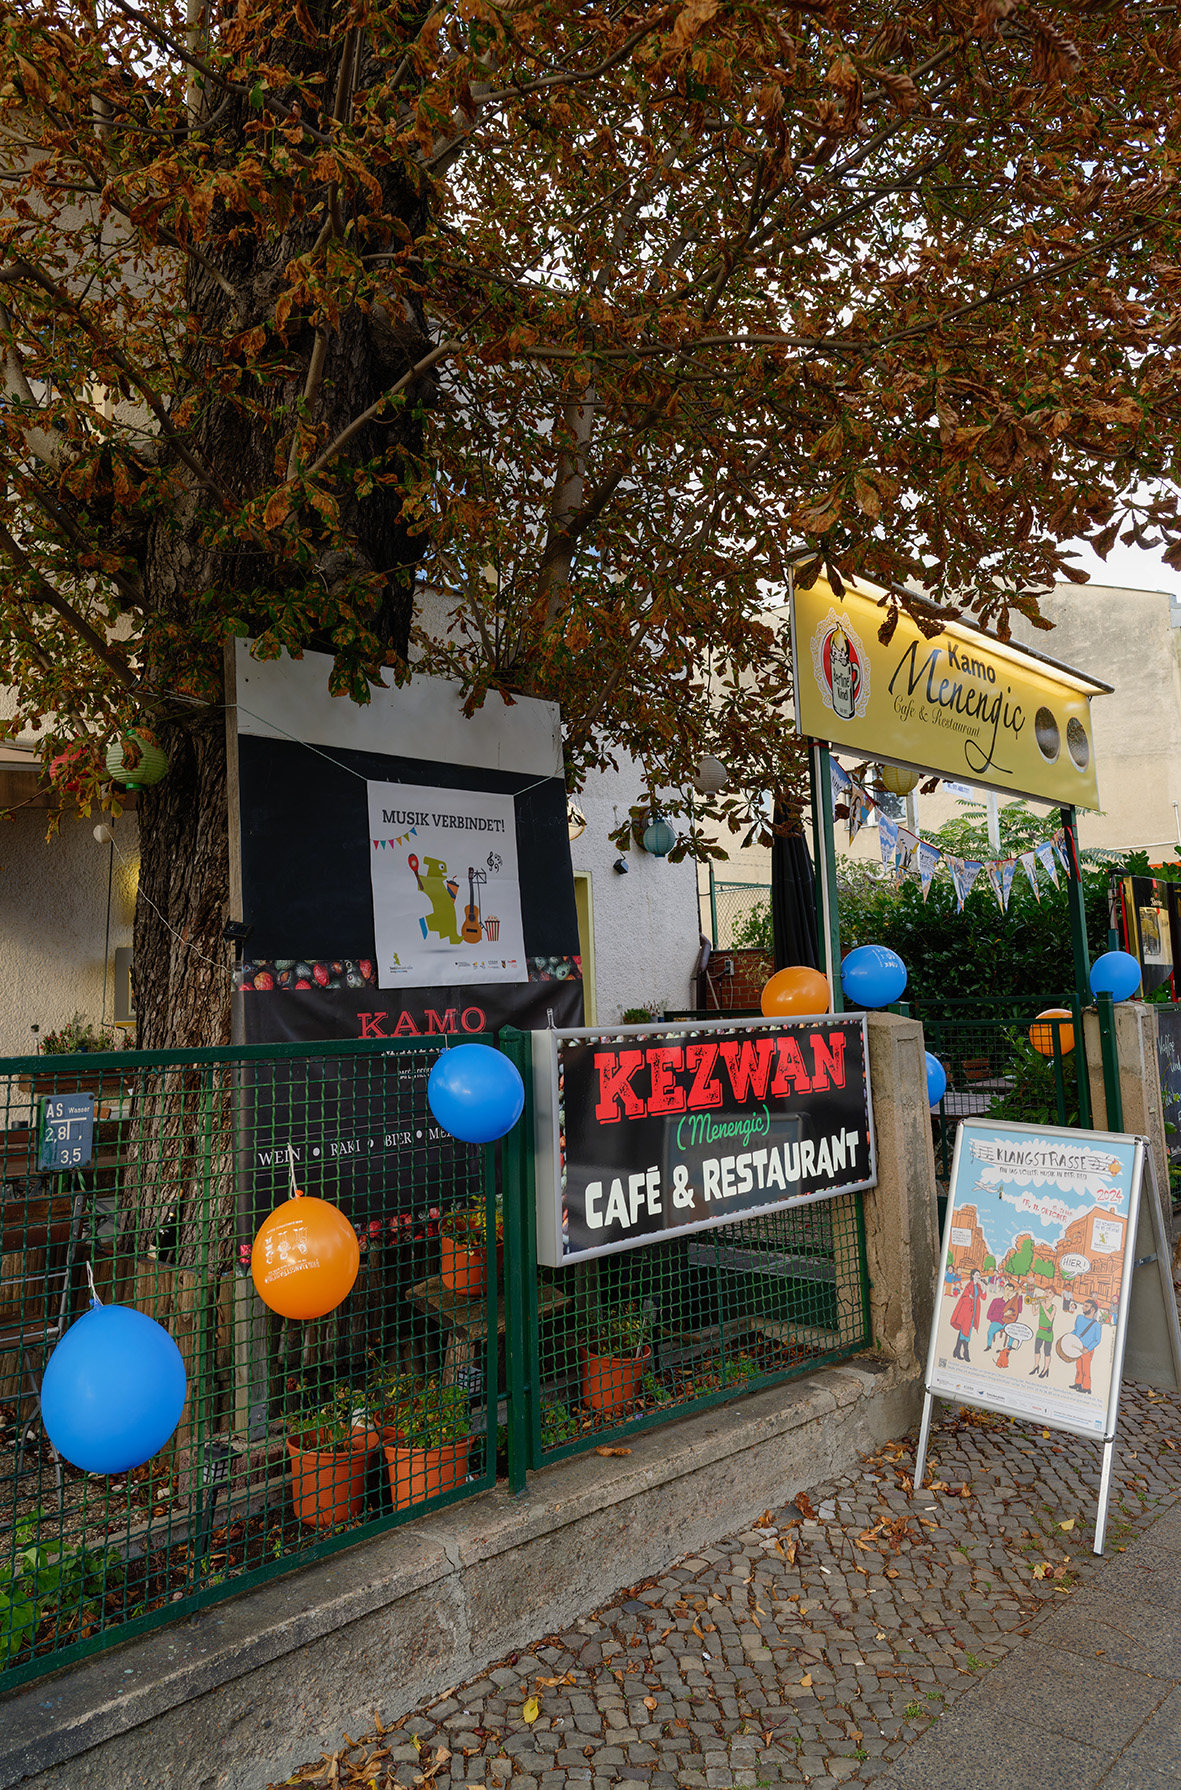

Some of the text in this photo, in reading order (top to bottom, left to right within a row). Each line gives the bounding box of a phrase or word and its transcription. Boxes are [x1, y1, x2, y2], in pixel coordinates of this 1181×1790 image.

[948, 641, 996, 683] Kamo
[894, 695, 980, 738] Cafe & Restaurant
[382, 810, 505, 832] MUSIK VERBINDET!
[357, 1006, 487, 1039] KAMO
[594, 1032, 846, 1124] KEZWAN
[46, 1102, 63, 1118] AS
[676, 1104, 770, 1151] (Menengic)
[60, 1147, 81, 1165] 3,5
[258, 1148, 300, 1166] WEIN
[330, 1139, 360, 1157] RAKI
[385, 1131, 412, 1147] BIER
[996, 1148, 1087, 1170] KLANGSTRASSE
[585, 1127, 859, 1229] CAFÉ & RESTAURANT
[1096, 1189, 1122, 1202] 2024
[1041, 1207, 1067, 1222] OKTOBER
